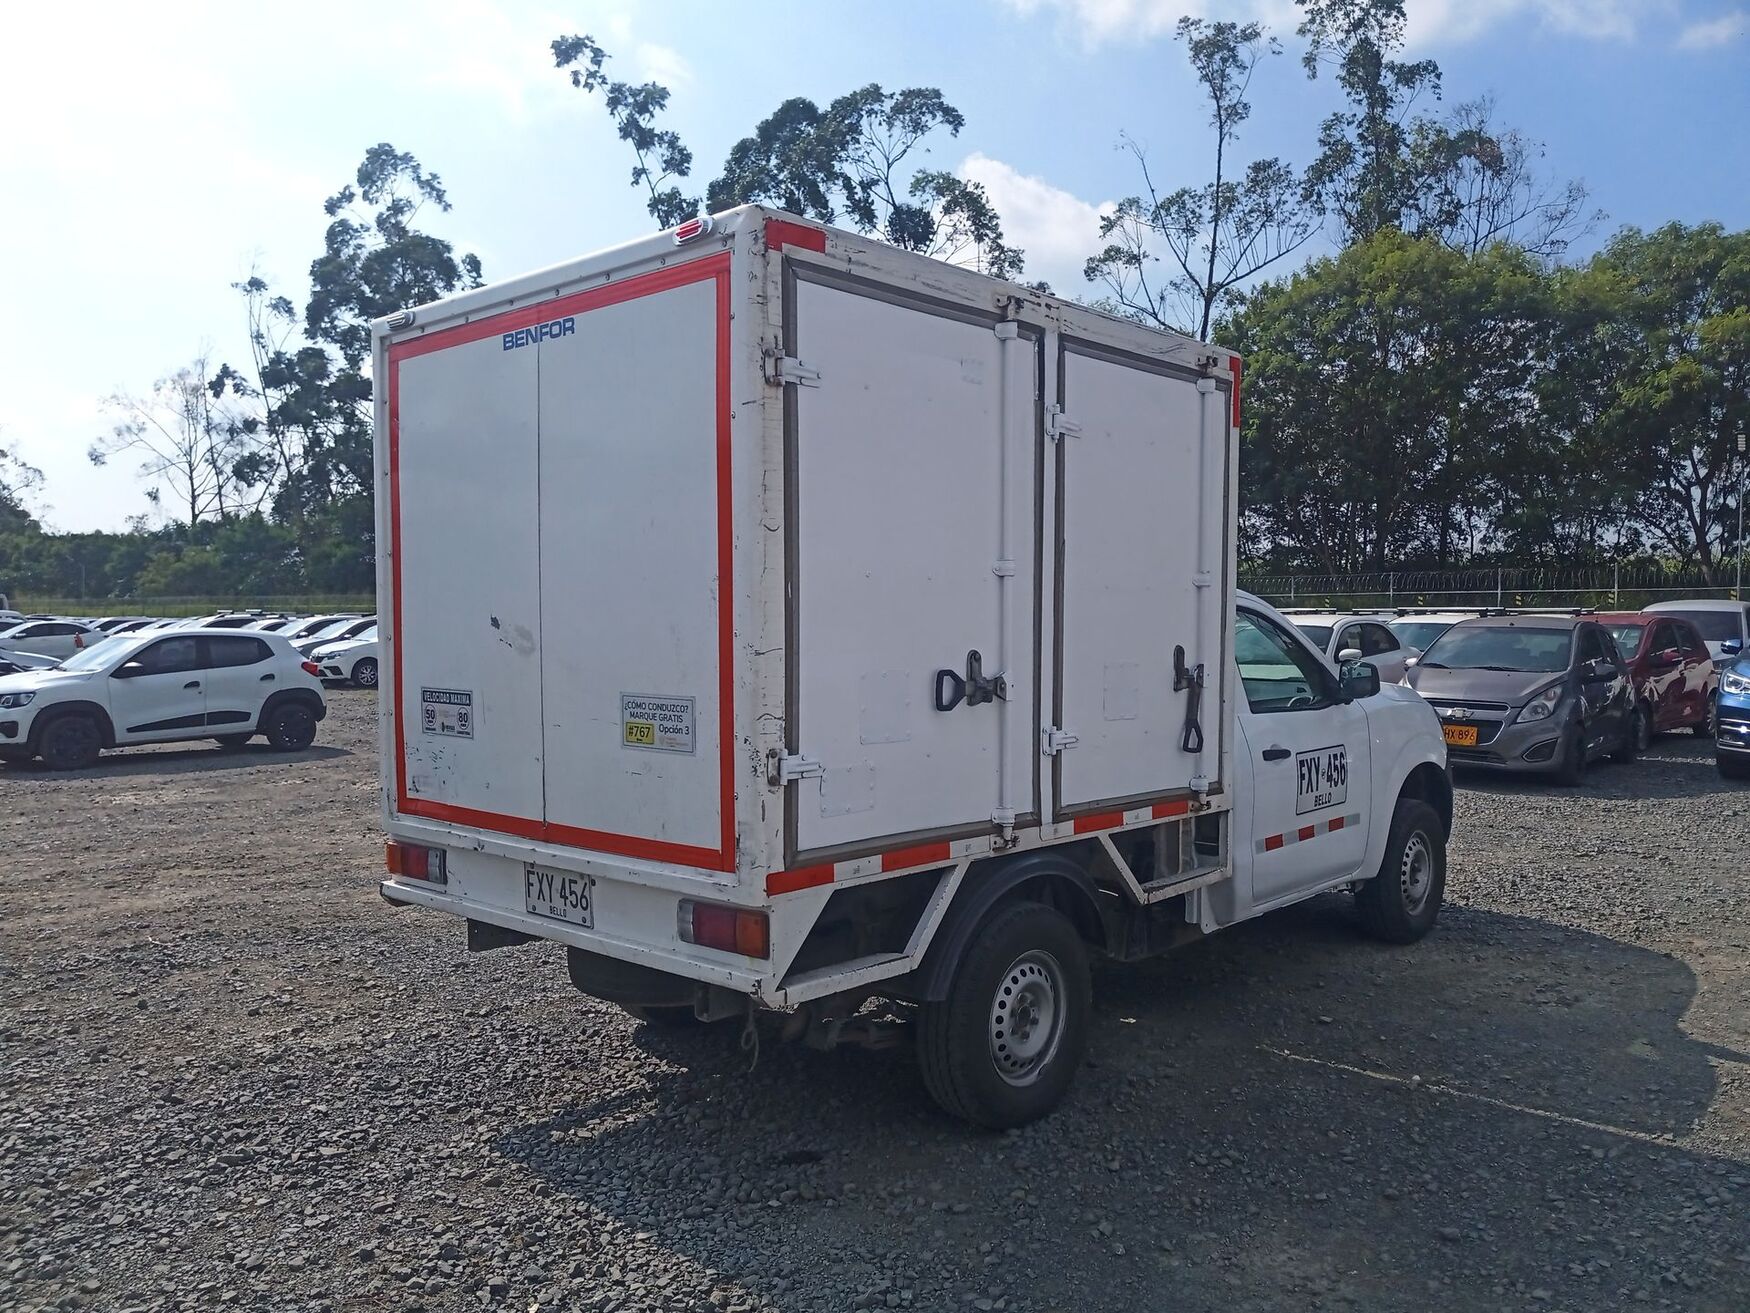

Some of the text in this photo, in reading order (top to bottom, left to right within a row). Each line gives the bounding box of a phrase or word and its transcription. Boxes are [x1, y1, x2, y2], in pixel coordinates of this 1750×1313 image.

[502, 317, 575, 351] BENFOR
[424, 691, 450, 703] VELOCIDAD
[647, 702, 689, 713] CONDUZCO?
[425, 709, 436, 720] 50
[458, 711, 469, 723] 80
[629, 711, 684, 723] MARQUE GRATIS
[628, 723, 690, 738] #767 Opción 3
[1444, 727, 1475, 741] HX 896
[1299, 751, 1346, 796] FXY 456
[1314, 792, 1332, 807] BELLO
[526, 869, 590, 912] FXY 456
[549, 905, 567, 918] BELLO
